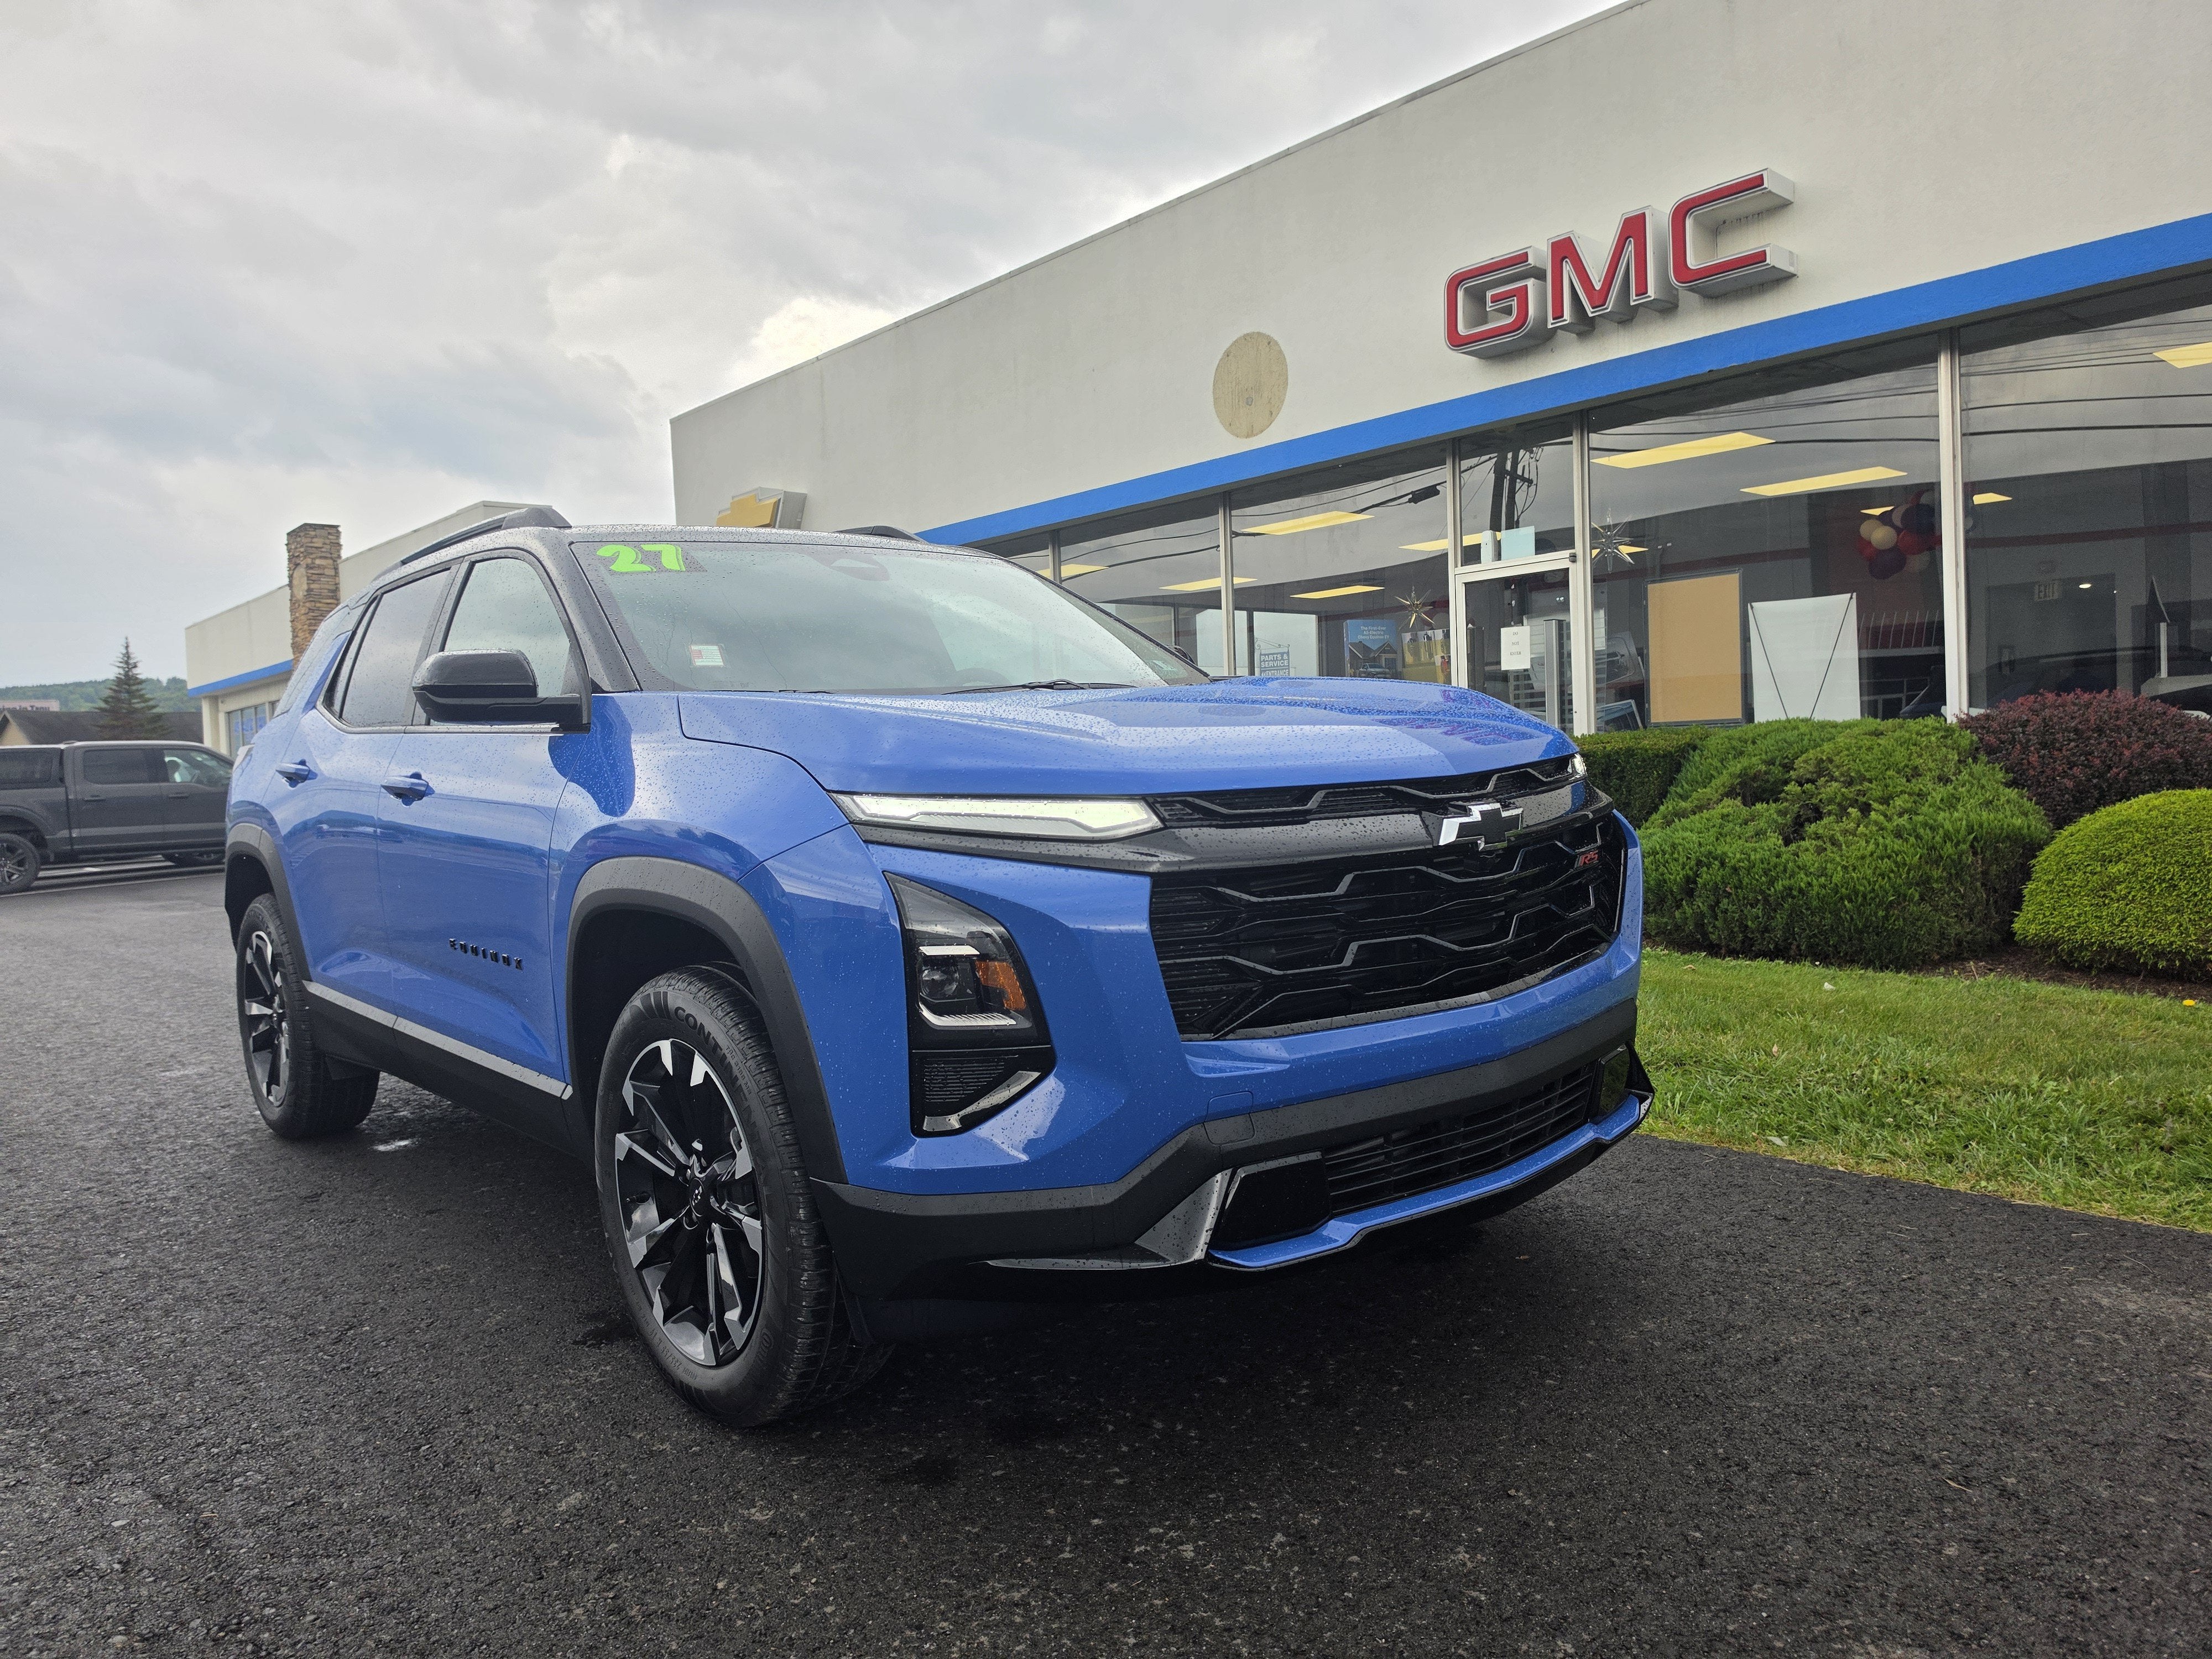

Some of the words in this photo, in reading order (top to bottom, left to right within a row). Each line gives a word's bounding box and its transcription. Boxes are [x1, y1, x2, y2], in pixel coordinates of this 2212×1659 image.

[1444, 168, 1778, 354] GMC
[597, 544, 686, 572] 27
[2038, 582, 2057, 599] EXIT
[1579, 850, 1598, 867] RS
[449, 938, 523, 971] EQUINOX
